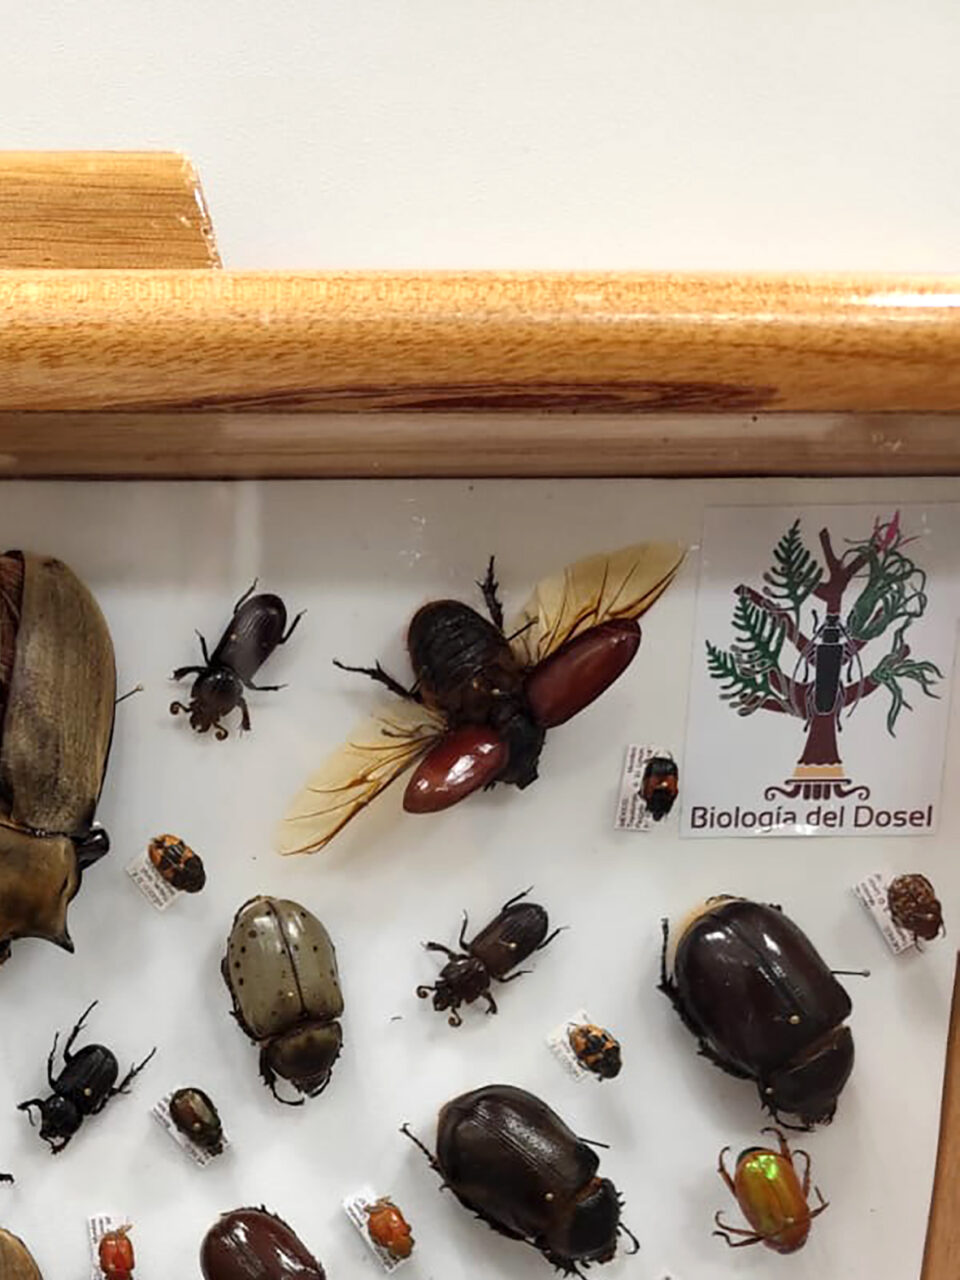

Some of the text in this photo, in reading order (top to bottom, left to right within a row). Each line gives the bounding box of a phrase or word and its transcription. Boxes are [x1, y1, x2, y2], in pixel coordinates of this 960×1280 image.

[691, 805, 933, 832] Biología del Dosel
